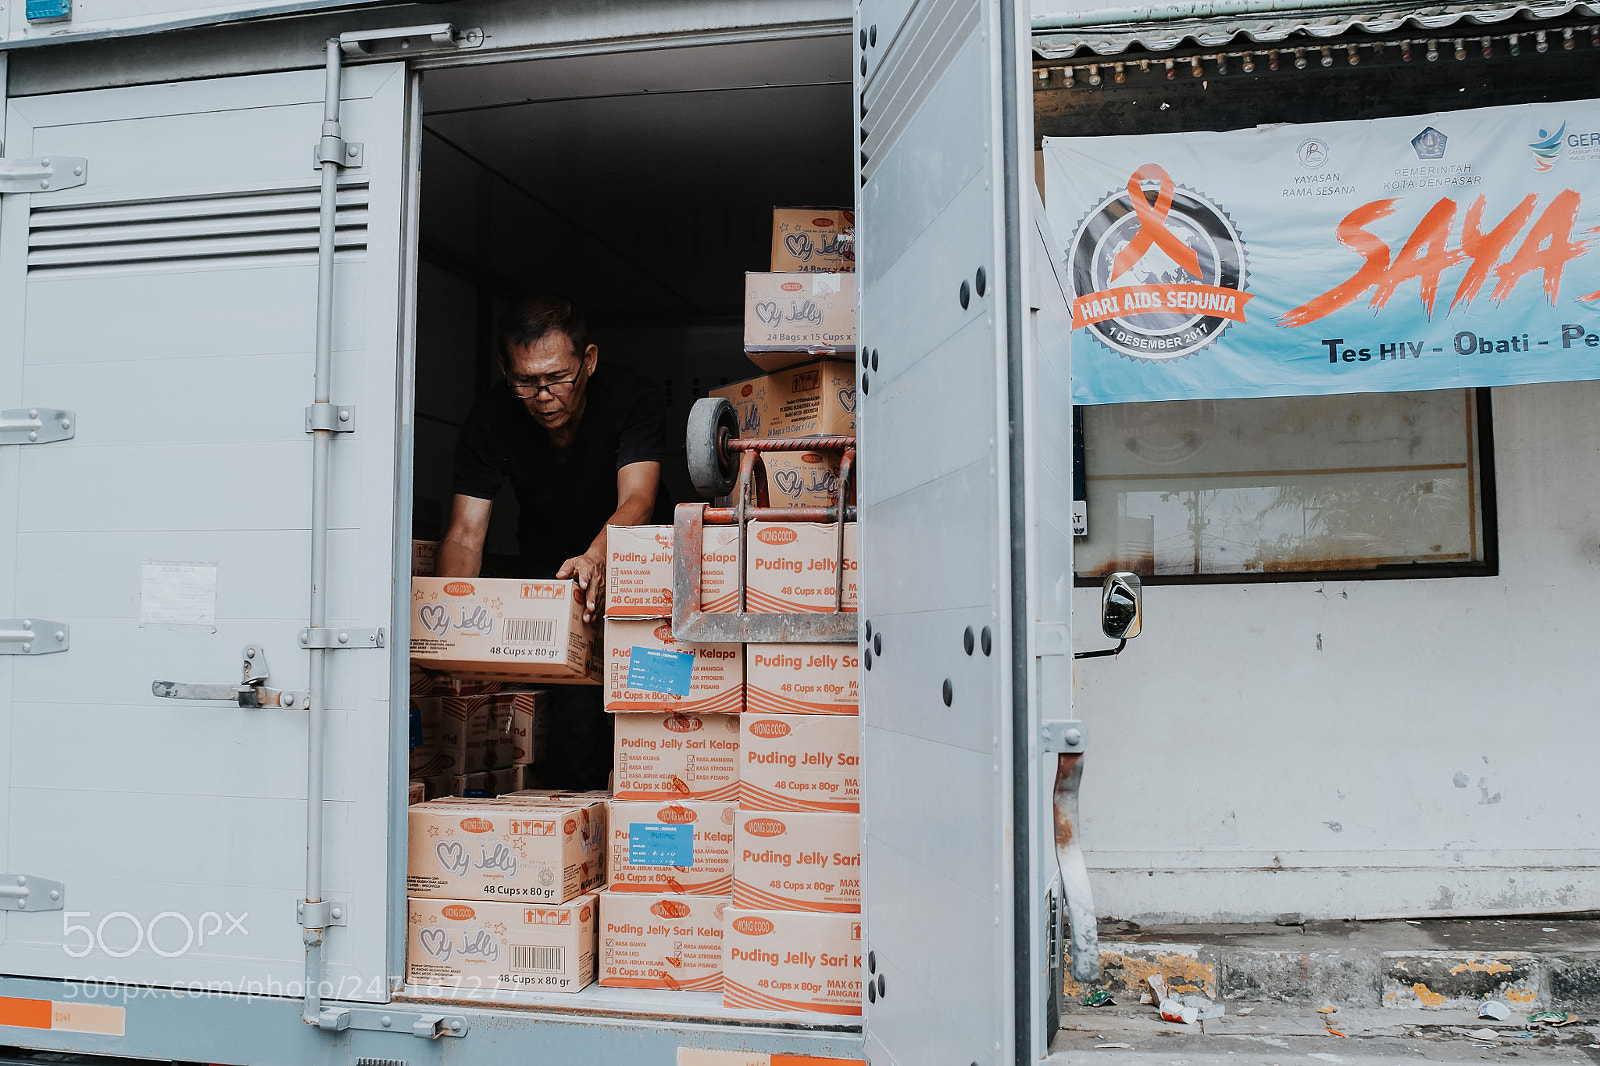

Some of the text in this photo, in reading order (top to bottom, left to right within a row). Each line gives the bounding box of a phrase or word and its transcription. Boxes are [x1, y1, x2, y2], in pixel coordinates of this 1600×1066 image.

[1395, 164, 1472, 177] PEMERINTAH
[1294, 173, 1340, 185] YAYASAN
[1384, 176, 1482, 190] KOTA DENPASAR
[1282, 185, 1356, 198] RAMA SESANA
[1270, 188, 1590, 328] SAYA
[1080, 291, 1236, 320] HARI AIDS SEDUNIA
[754, 300, 824, 329] My jelly
[767, 333, 777, 341] 24
[779, 333, 800, 342] Bags
[823, 333, 844, 342] Cups
[1109, 323, 1208, 349] 1 DESEMBER 2017
[1321, 339, 1371, 364] Tes
[1380, 341, 1424, 361] HIV
[1454, 331, 1528, 356] Obati
[1561, 324, 1600, 349] Pe
[773, 469, 804, 500] My
[761, 530, 793, 541] WONG COCO
[613, 552, 736, 565] Puding Jelly Kelapa
[755, 557, 802, 573] Puding
[807, 557, 837, 574] Jelly
[781, 587, 792, 595] 48
[794, 587, 814, 597] Cups
[611, 596, 622, 604] 48
[624, 596, 643, 605] Cups
[419, 603, 494, 637] My jelly
[490, 646, 501, 655] 48
[503, 647, 525, 657] Cups
[535, 648, 547, 657] 80
[549, 650, 559, 659] gr
[700, 649, 736, 659] Kelapa
[755, 654, 802, 670] Puding
[807, 655, 838, 671] Jelly
[781, 684, 792, 692] 48
[794, 684, 814, 693] Cups
[824, 684, 844, 694] 80gr
[611, 691, 622, 699] 48
[624, 691, 643, 701] Cups
[754, 724, 786, 734] WONG COCO
[621, 738, 739, 752] Puding Jelly Sari Kelap
[748, 751, 796, 767] Puding
[801, 752, 833, 768] Jelly
[620, 781, 631, 789] 48
[633, 781, 652, 791] Cups
[775, 781, 786, 789] 48
[788, 781, 809, 791] Cups
[819, 782, 839, 792] 80gr
[463, 820, 490, 831] WONG COCO
[749, 822, 782, 833] WONG COCO
[435, 840, 518, 879] My jelly
[743, 850, 860, 868] Puding Jelly Sari
[614, 873, 625, 881] 48
[627, 873, 646, 883] Cups
[840, 879, 860, 887] MAX
[483, 886, 496, 894] 48
[497, 886, 520, 896] Cups
[530, 887, 542, 896] 80
[544, 889, 555, 898] gr
[770, 880, 781, 889] 48
[783, 881, 804, 891] Cups
[814, 882, 834, 892] 80gr
[458, 908, 471, 918] COCO
[607, 924, 643, 936] Puding
[647, 925, 670, 937] Jelly
[673, 926, 693, 936] Sari
[737, 921, 769, 932] WONG COCO
[419, 926, 499, 963] My jelly
[731, 948, 779, 966] Puding
[784, 951, 816, 968] Jelly
[820, 953, 848, 967] Sari
[606, 967, 617, 975] 48
[619, 968, 638, 977] Cups
[498, 975, 510, 983] 48
[513, 975, 535, 985] Cups
[545, 976, 557, 985] 80
[559, 978, 570, 987] gr
[757, 980, 769, 988] 48
[771, 980, 791, 991] Cups
[801, 982, 822, 993] 80gr
[827, 980, 854, 989] MAX 6
[827, 990, 859, 998] JANGAN
